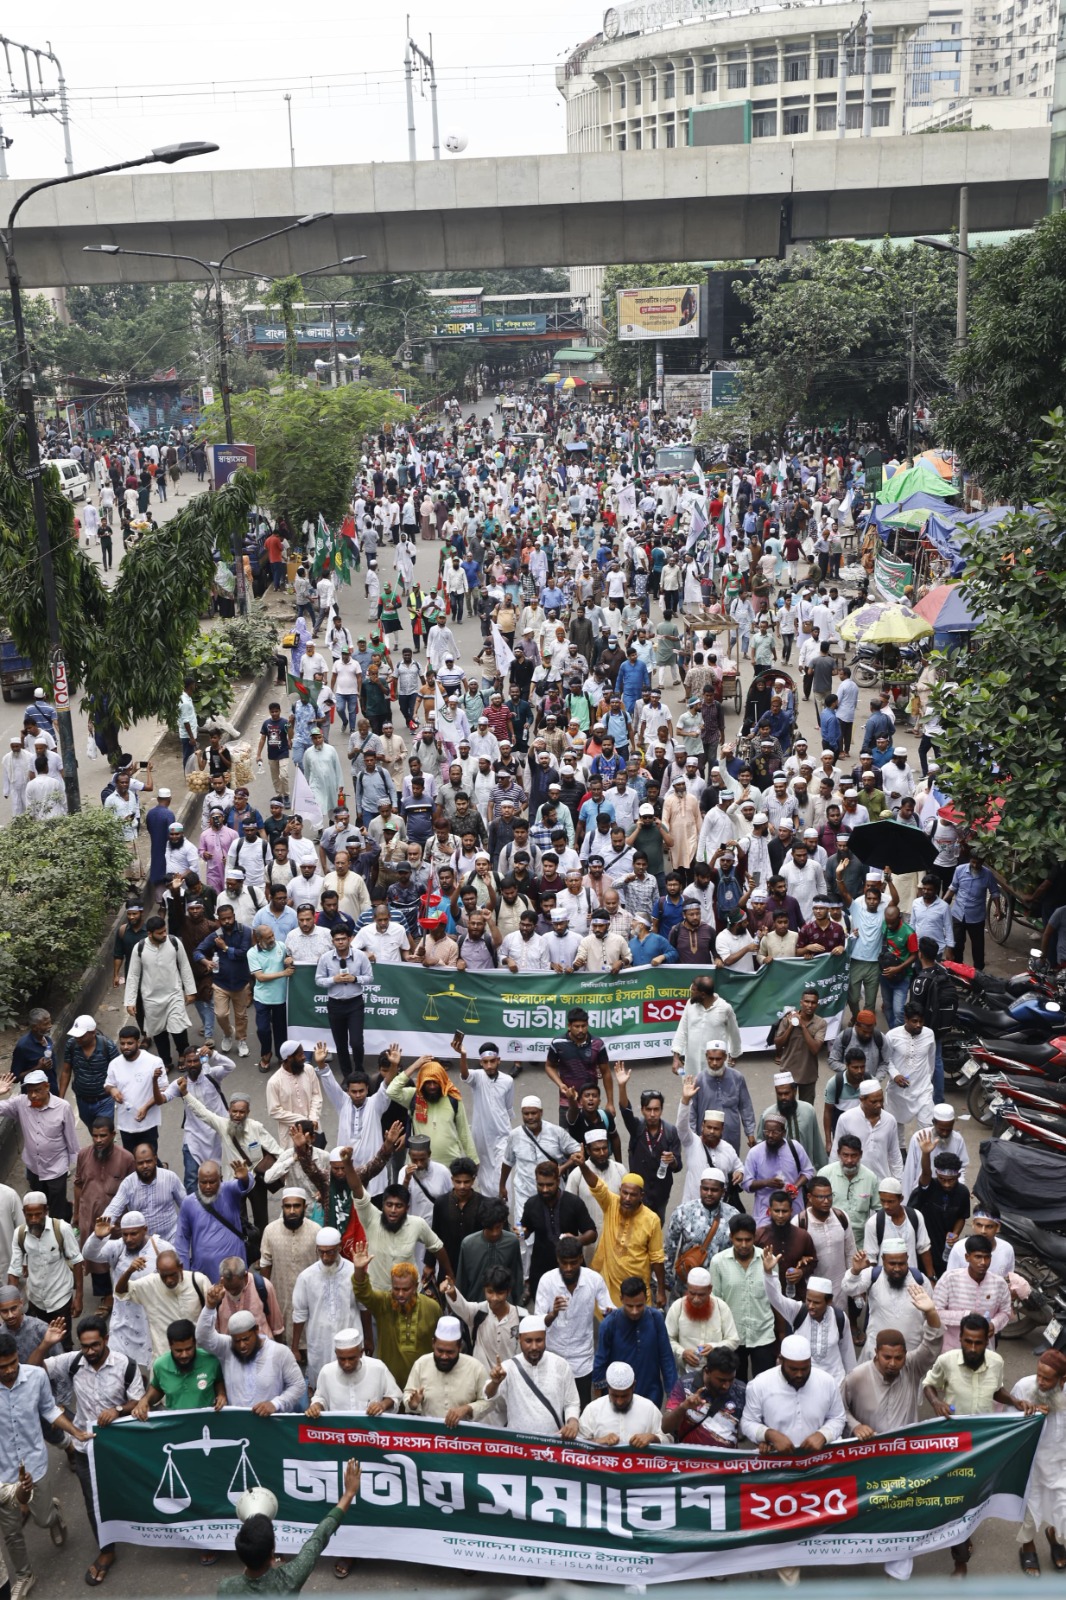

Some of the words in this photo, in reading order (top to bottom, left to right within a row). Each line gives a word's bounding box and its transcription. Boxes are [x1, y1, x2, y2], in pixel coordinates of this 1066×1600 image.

[52, 665, 68, 704] UCC
[370, 993, 400, 1004] উদ্যানে
[501, 993, 558, 1004] বাংলাদেশ
[560, 993, 613, 1005] জামায়াতে
[616, 984, 656, 1002] ইসলামী
[658, 988, 691, 998] আয়ো
[377, 1007, 398, 1016] হোক
[502, 1005, 566, 1030] জাতীয়
[587, 1006, 640, 1029] মাবেশ
[648, 1001, 686, 1020] ২০২
[608, 1041, 640, 1051] ফোরাম
[644, 1039, 660, 1048] অব
[306, 1429, 346, 1444] আসন্ন
[348, 1431, 390, 1447] জাতীয়
[392, 1436, 432, 1448] সংসদ
[434, 1435, 482, 1452] নির্বাচন
[484, 1442, 528, 1457] অবাধ,
[561, 1449, 619, 1468] নিরপেক্ষ
[622, 1457, 633, 1468] ও
[636, 1456, 719, 1473] শান্তিপূর্ণভাবে
[723, 1457, 792, 1474] অনুষ্ঠানের
[795, 1452, 834, 1467] লক্ষ্যে
[836, 1449, 846, 1459] ৭
[848, 1443, 876, 1457] দফা
[878, 1440, 907, 1453] দাবি
[910, 1436, 960, 1451] আদায়ে
[866, 1481, 880, 1490] ১৯
[880, 1476, 906, 1493] জুলাই
[283, 1454, 464, 1514] জাতীয়
[478, 1472, 726, 1540] সমাবেশ
[750, 1488, 848, 1520] ২০২৫
[916, 1496, 943, 1508] উদ্যান,
[944, 1495, 964, 1505] ঢাকা
[130, 1523, 204, 1534] বাংলাদেশ
[443, 1536, 516, 1552] বাংলাদেশ
[519, 1544, 592, 1560] জামায়াতে
[595, 1551, 654, 1566] ইসলামী
[797, 1538, 872, 1547] বাংলাদেশ
[453, 1548, 644, 1575] WWW.JAMAAT-E-ISLAMI.ORG
